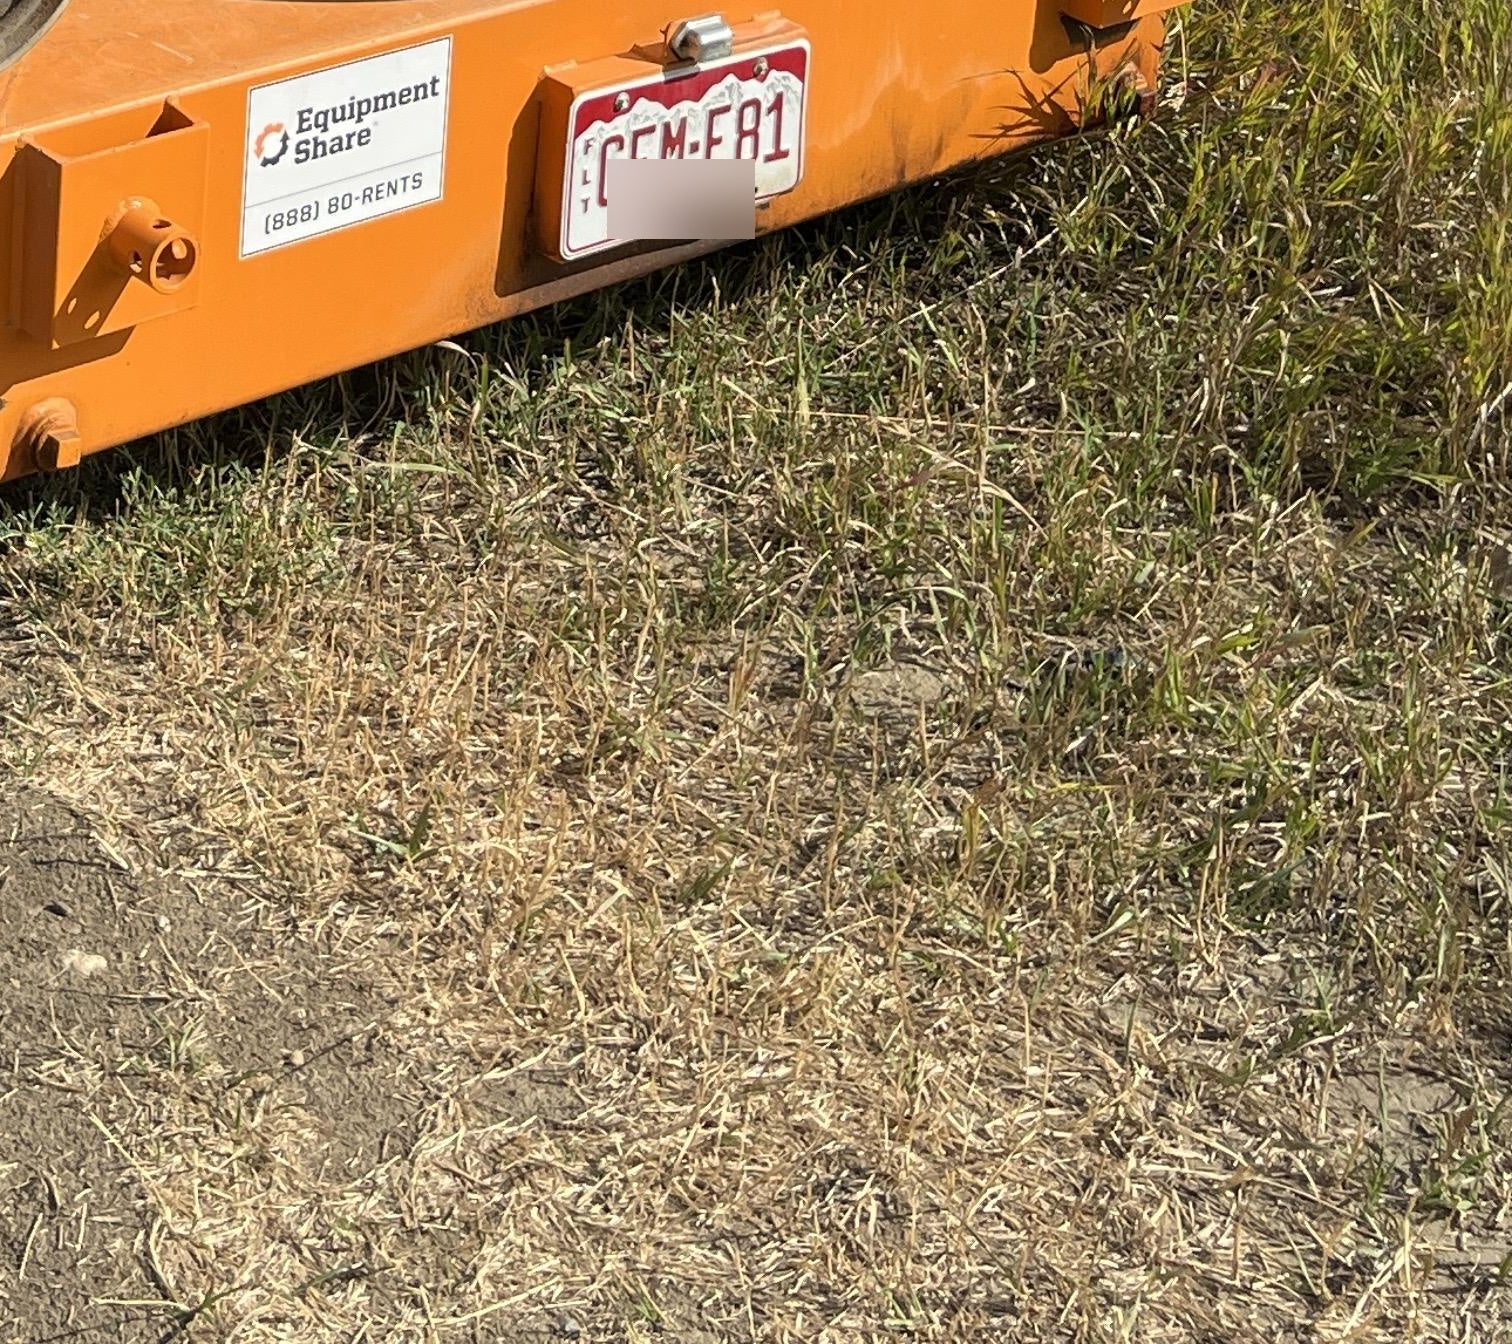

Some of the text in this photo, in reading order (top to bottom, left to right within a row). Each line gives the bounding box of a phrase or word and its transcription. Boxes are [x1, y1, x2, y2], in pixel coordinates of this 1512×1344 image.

[295, 74, 440, 134] Equipment
[294, 126, 372, 165] Share
[264, 171, 424, 235] (888) 80-RENTS
